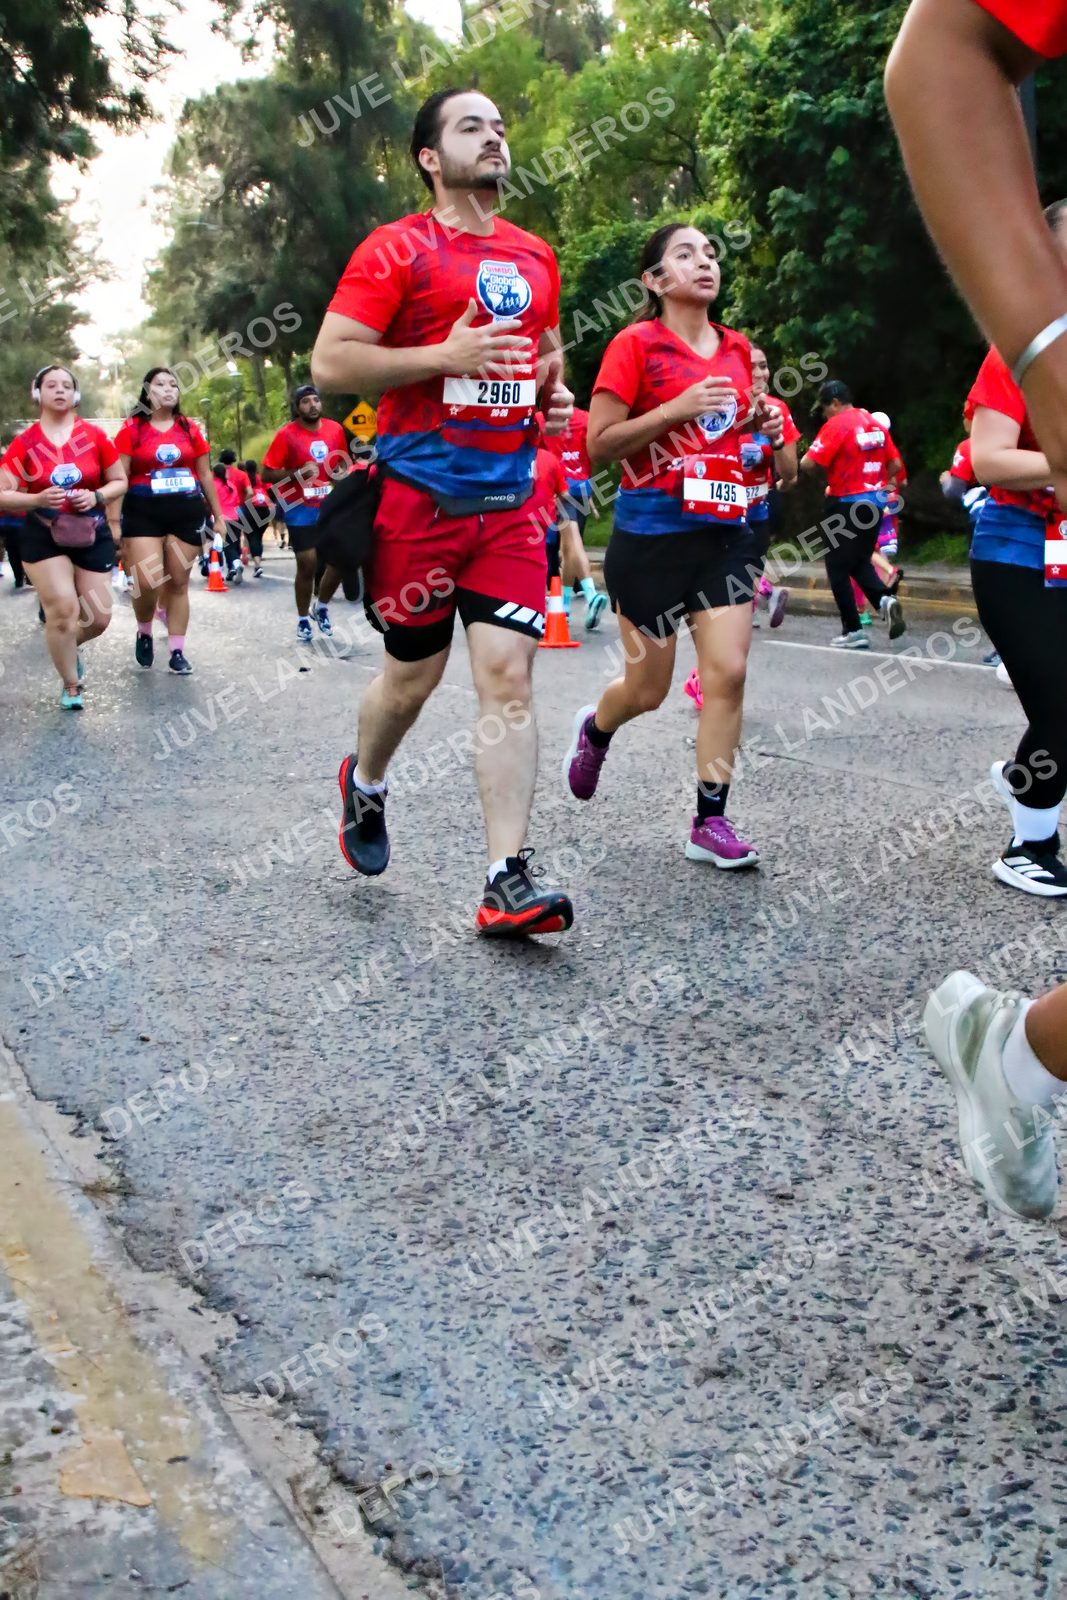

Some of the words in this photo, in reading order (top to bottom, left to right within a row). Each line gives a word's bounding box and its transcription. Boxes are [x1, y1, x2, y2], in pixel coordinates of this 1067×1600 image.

[486, 281, 509, 294] Race
[489, 275, 517, 287] Global
[477, 381, 521, 405] 2960
[709, 481, 737, 503] 1435
